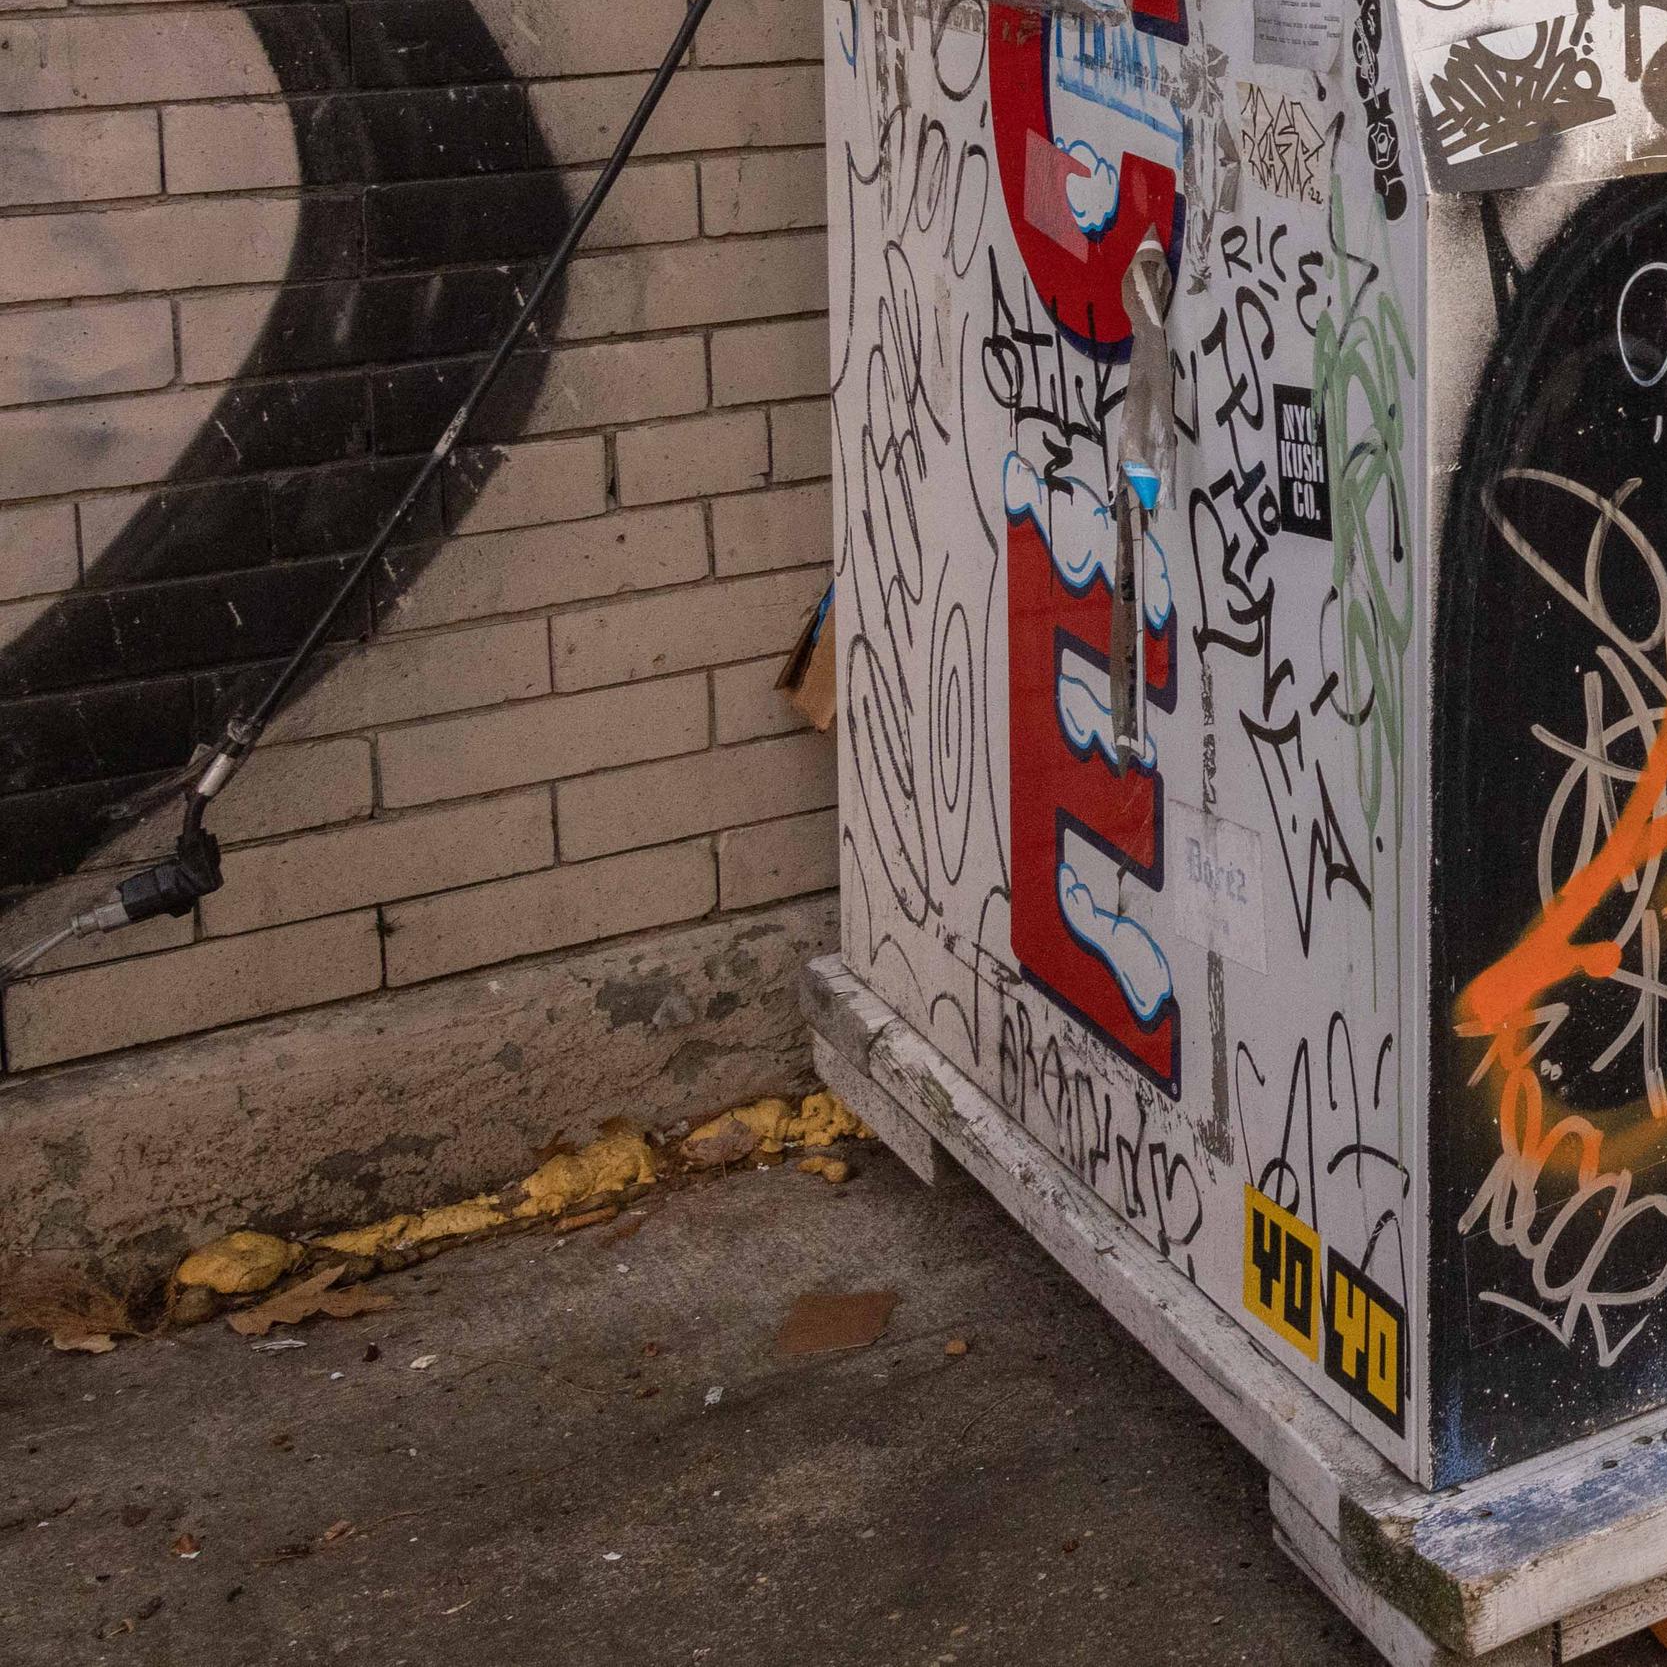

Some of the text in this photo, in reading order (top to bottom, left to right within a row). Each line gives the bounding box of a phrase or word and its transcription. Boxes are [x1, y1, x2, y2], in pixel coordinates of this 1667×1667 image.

[1281, 403, 1323, 441] NYC
[1280, 442, 1324, 484] KUSH
[1291, 488, 1322, 522] CO.
[1252, 1206, 1315, 1341] YO
[1332, 1266, 1400, 1416] YO
